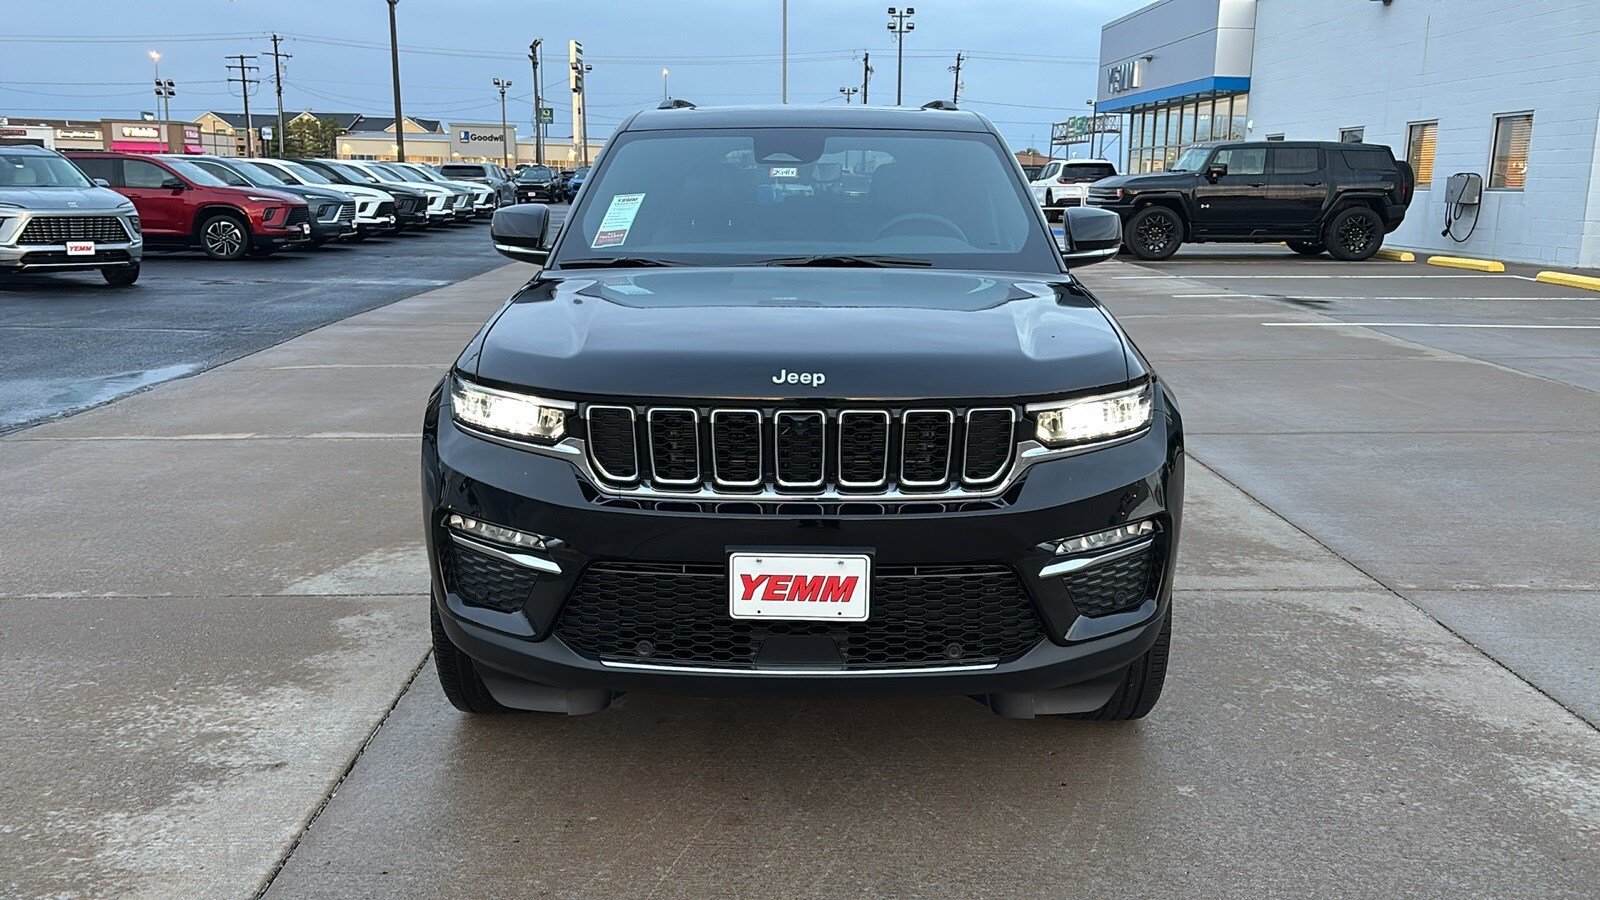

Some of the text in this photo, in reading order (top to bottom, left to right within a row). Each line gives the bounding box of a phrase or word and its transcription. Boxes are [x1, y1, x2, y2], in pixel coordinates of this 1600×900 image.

[470, 133, 503, 142] Goodwil
[772, 369, 826, 387] Jeep
[740, 574, 859, 603] YEMM
